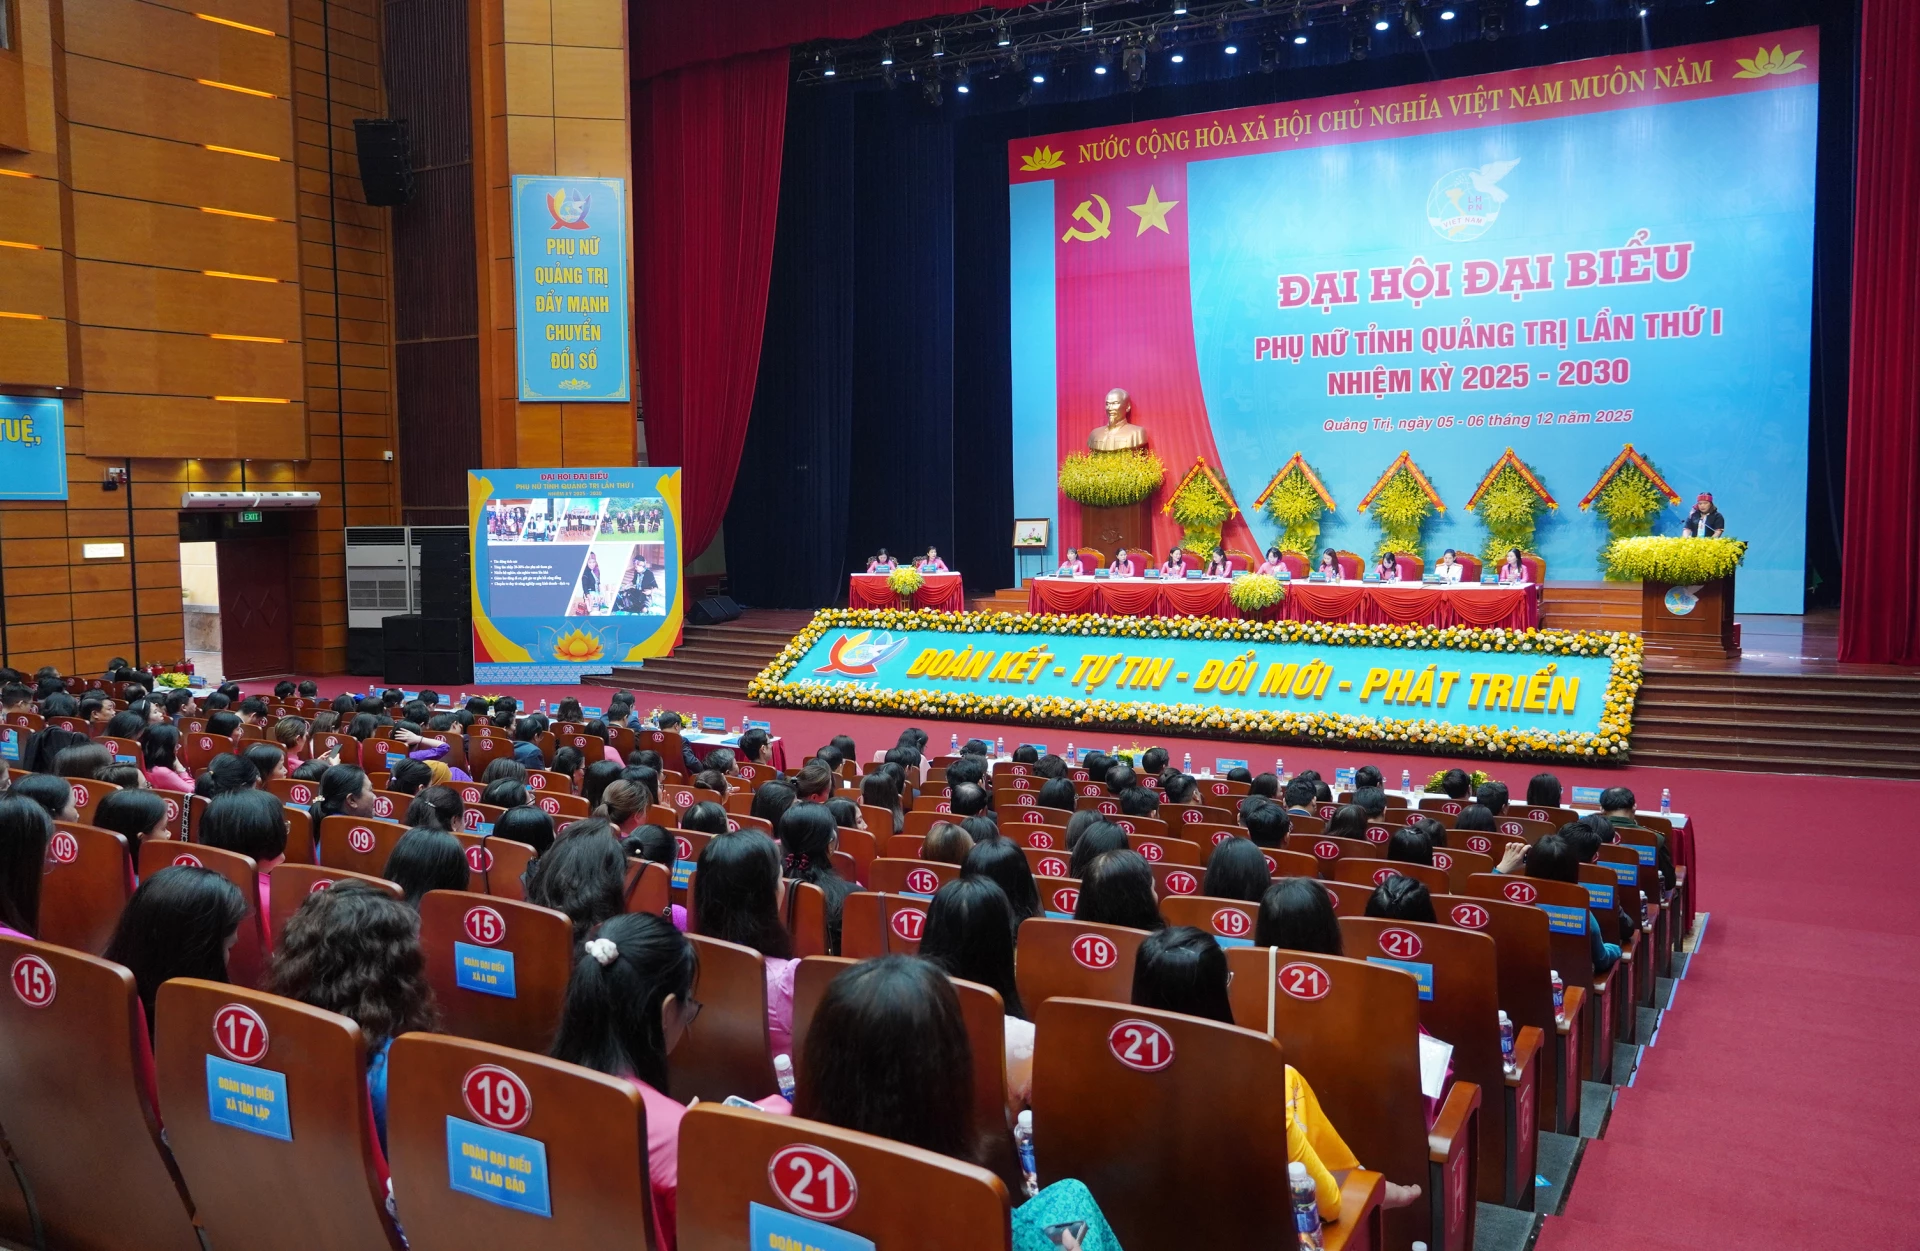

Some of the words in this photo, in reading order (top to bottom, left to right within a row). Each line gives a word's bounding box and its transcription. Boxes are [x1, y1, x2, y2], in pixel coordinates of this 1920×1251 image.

[1079, 133, 1130, 163] NƯỚC
[1135, 128, 1189, 161] CỘNG
[1195, 121, 1237, 148] HÒA
[1241, 115, 1269, 143] XÃ
[1274, 110, 1312, 144] HỘI
[1318, 99, 1363, 132] CHỦ
[1370, 94, 1442, 127] NGHĨA
[1448, 85, 1503, 119] VIỆT
[1509, 81, 1563, 109] NAM
[1570, 65, 1646, 100] MUÔN
[1653, 58, 1713, 90] NĂM
[547, 238, 575, 259] PHỤ
[579, 236, 601, 256] NỮ
[535, 262, 583, 284] QUẢNG
[587, 267, 608, 288] TRỊ
[1279, 271, 1358, 313] ĐẠI
[1370, 257, 1451, 307] HỘI
[1463, 255, 1554, 301] ĐẠI
[1566, 230, 1693, 288] BIỂU
[535, 290, 563, 313] ĐẨY
[567, 296, 609, 316] MẠNH
[545, 318, 601, 341] CHUYỂN
[1255, 334, 1303, 363] PHỤ
[1312, 328, 1349, 358] NỮ
[1355, 323, 1413, 355] TỈNH
[1422, 317, 1514, 352] QUẢNG
[1523, 318, 1568, 351] TRỊ
[1577, 307, 1634, 344] LẦN
[1642, 305, 1704, 339] THỨ
[1712, 308, 1723, 335] I
[551, 346, 575, 369] ĐỔI
[578, 347, 598, 369] SỐ
[1328, 367, 1411, 399] NHIỆM
[1420, 361, 1454, 393] KỲ
[1462, 363, 1529, 391] 2025
[1558, 358, 1630, 387] 2030
[1323, 416, 1368, 432] Quảng
[1372, 417, 1394, 432] Trị,
[1398, 417, 1433, 431] ngày
[1437, 415, 1454, 428] 05
[1467, 415, 1484, 427] 06
[1488, 413, 1531, 429] tháng
[1537, 412, 1553, 425] 12
[1557, 411, 1591, 424] năm
[1596, 409, 1633, 423] 2025
[244, 513, 259, 521] EXIT
[906, 644, 996, 682] ĐOÀN
[988, 643, 1056, 684] KẾT
[1071, 653, 1123, 694] TỰ
[1116, 656, 1174, 691] TIN
[1194, 650, 1259, 694] ĐỔI
[1258, 658, 1335, 699] MỚI
[1360, 664, 1461, 708] PHÁT
[1468, 662, 1580, 714] TRIỂN
[203, 740, 211, 748] 04
[576, 738, 585, 746] 02
[654, 733, 663, 742] 02
[107, 742, 116, 753] 02
[378, 743, 387, 752] 02
[483, 741, 491, 749] 02
[743, 768, 752, 778] 01
[1014, 767, 1024, 775] 05
[1076, 773, 1087, 781] 07
[533, 777, 543, 788] 01
[1016, 780, 1026, 789] 07
[1145, 779, 1156, 788] 09
[73, 789, 85, 802] 03
[295, 789, 306, 801] 03
[1086, 787, 1097, 796] 09
[1216, 785, 1225, 794] 11
[466, 791, 476, 802] 03
[678, 793, 690, 805] 05
[1021, 796, 1032, 806] 09
[376, 800, 388, 813] 05
[543, 800, 557, 812] 05
[940, 806, 950, 814] 09
[1103, 804, 1113, 814] 11
[1446, 804, 1457, 814] 17
[466, 812, 479, 828] 07
[1028, 814, 1039, 823] 11
[1187, 812, 1199, 823] 13
[1323, 808, 1335, 819] 15
[1533, 812, 1545, 821] 19
[1370, 830, 1383, 841] 17
[1505, 824, 1519, 835] 19
[353, 831, 369, 849] 09
[1034, 835, 1047, 848] 13
[1472, 839, 1486, 850] 19
[56, 839, 71, 856] 09
[1143, 847, 1158, 860] 15
[1320, 844, 1333, 857] 17
[1434, 855, 1446, 868] 19
[1045, 862, 1060, 877] 15
[913, 873, 932, 892] 15
[1172, 875, 1190, 891] 17
[1511, 885, 1529, 900] 21
[1061, 892, 1078, 910] 17
[1219, 913, 1242, 932] 19
[1459, 908, 1481, 926] 21
[471, 912, 496, 940] 15
[900, 914, 922, 936] 17
[1389, 934, 1412, 955] 21
[1082, 940, 1108, 964] 19
[20, 964, 45, 999] 15
[1290, 969, 1320, 995] 21
[224, 1014, 255, 1053] 17
[1123, 1029, 1159, 1064] 21
[218, 1077, 239, 1093] ĐOÀN
[241, 1083, 254, 1098] ĐẠI
[477, 1075, 516, 1120] 19
[226, 1097, 237, 1111] XÃ
[238, 1100, 253, 1115] TÂN
[255, 1104, 270, 1120] LẬP
[462, 1142, 488, 1162] ĐOÀN
[490, 1150, 506, 1168] ĐẠI
[508, 1154, 531, 1174] BIỂU
[470, 1165, 483, 1181] XÃ
[485, 1171, 502, 1188] LAO
[505, 1174, 525, 1193] BẢO
[790, 1157, 836, 1209] 21
